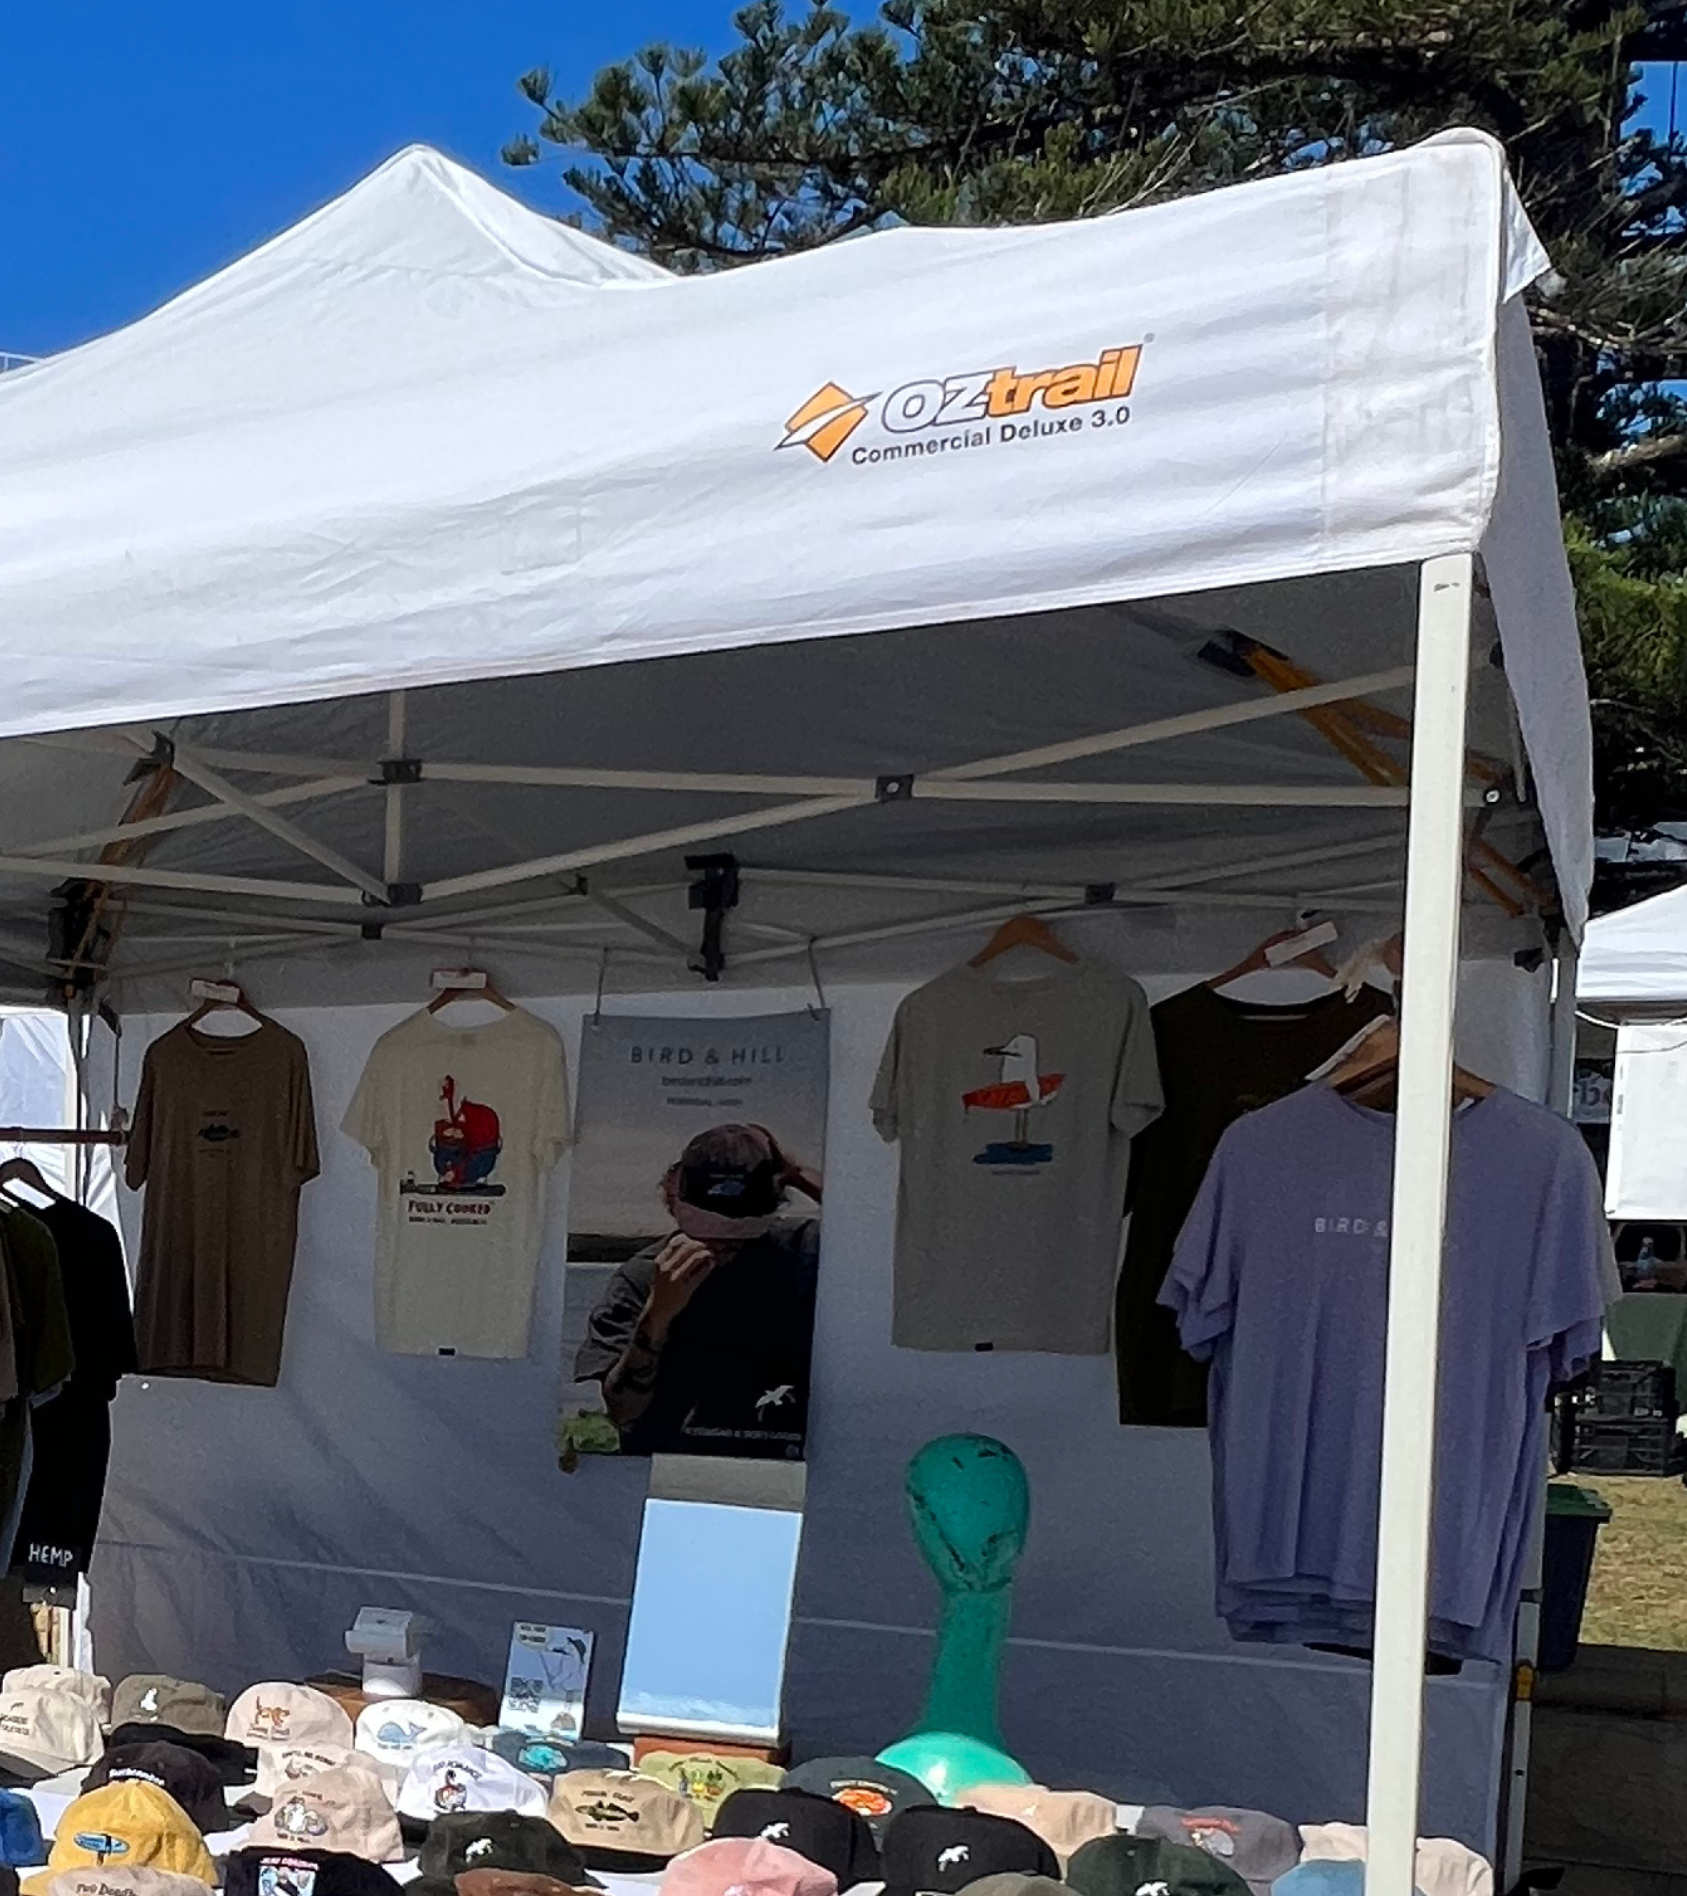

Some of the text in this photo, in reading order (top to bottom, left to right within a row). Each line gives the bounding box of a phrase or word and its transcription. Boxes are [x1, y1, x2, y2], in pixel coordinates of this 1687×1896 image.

[852, 406, 1131, 465] Commercial Deluxe 3.0
[630, 1045, 785, 1065] BIRD & HILL
[1314, 1216, 1369, 1235] BIRD
[28, 1542, 74, 1568] HEMP
